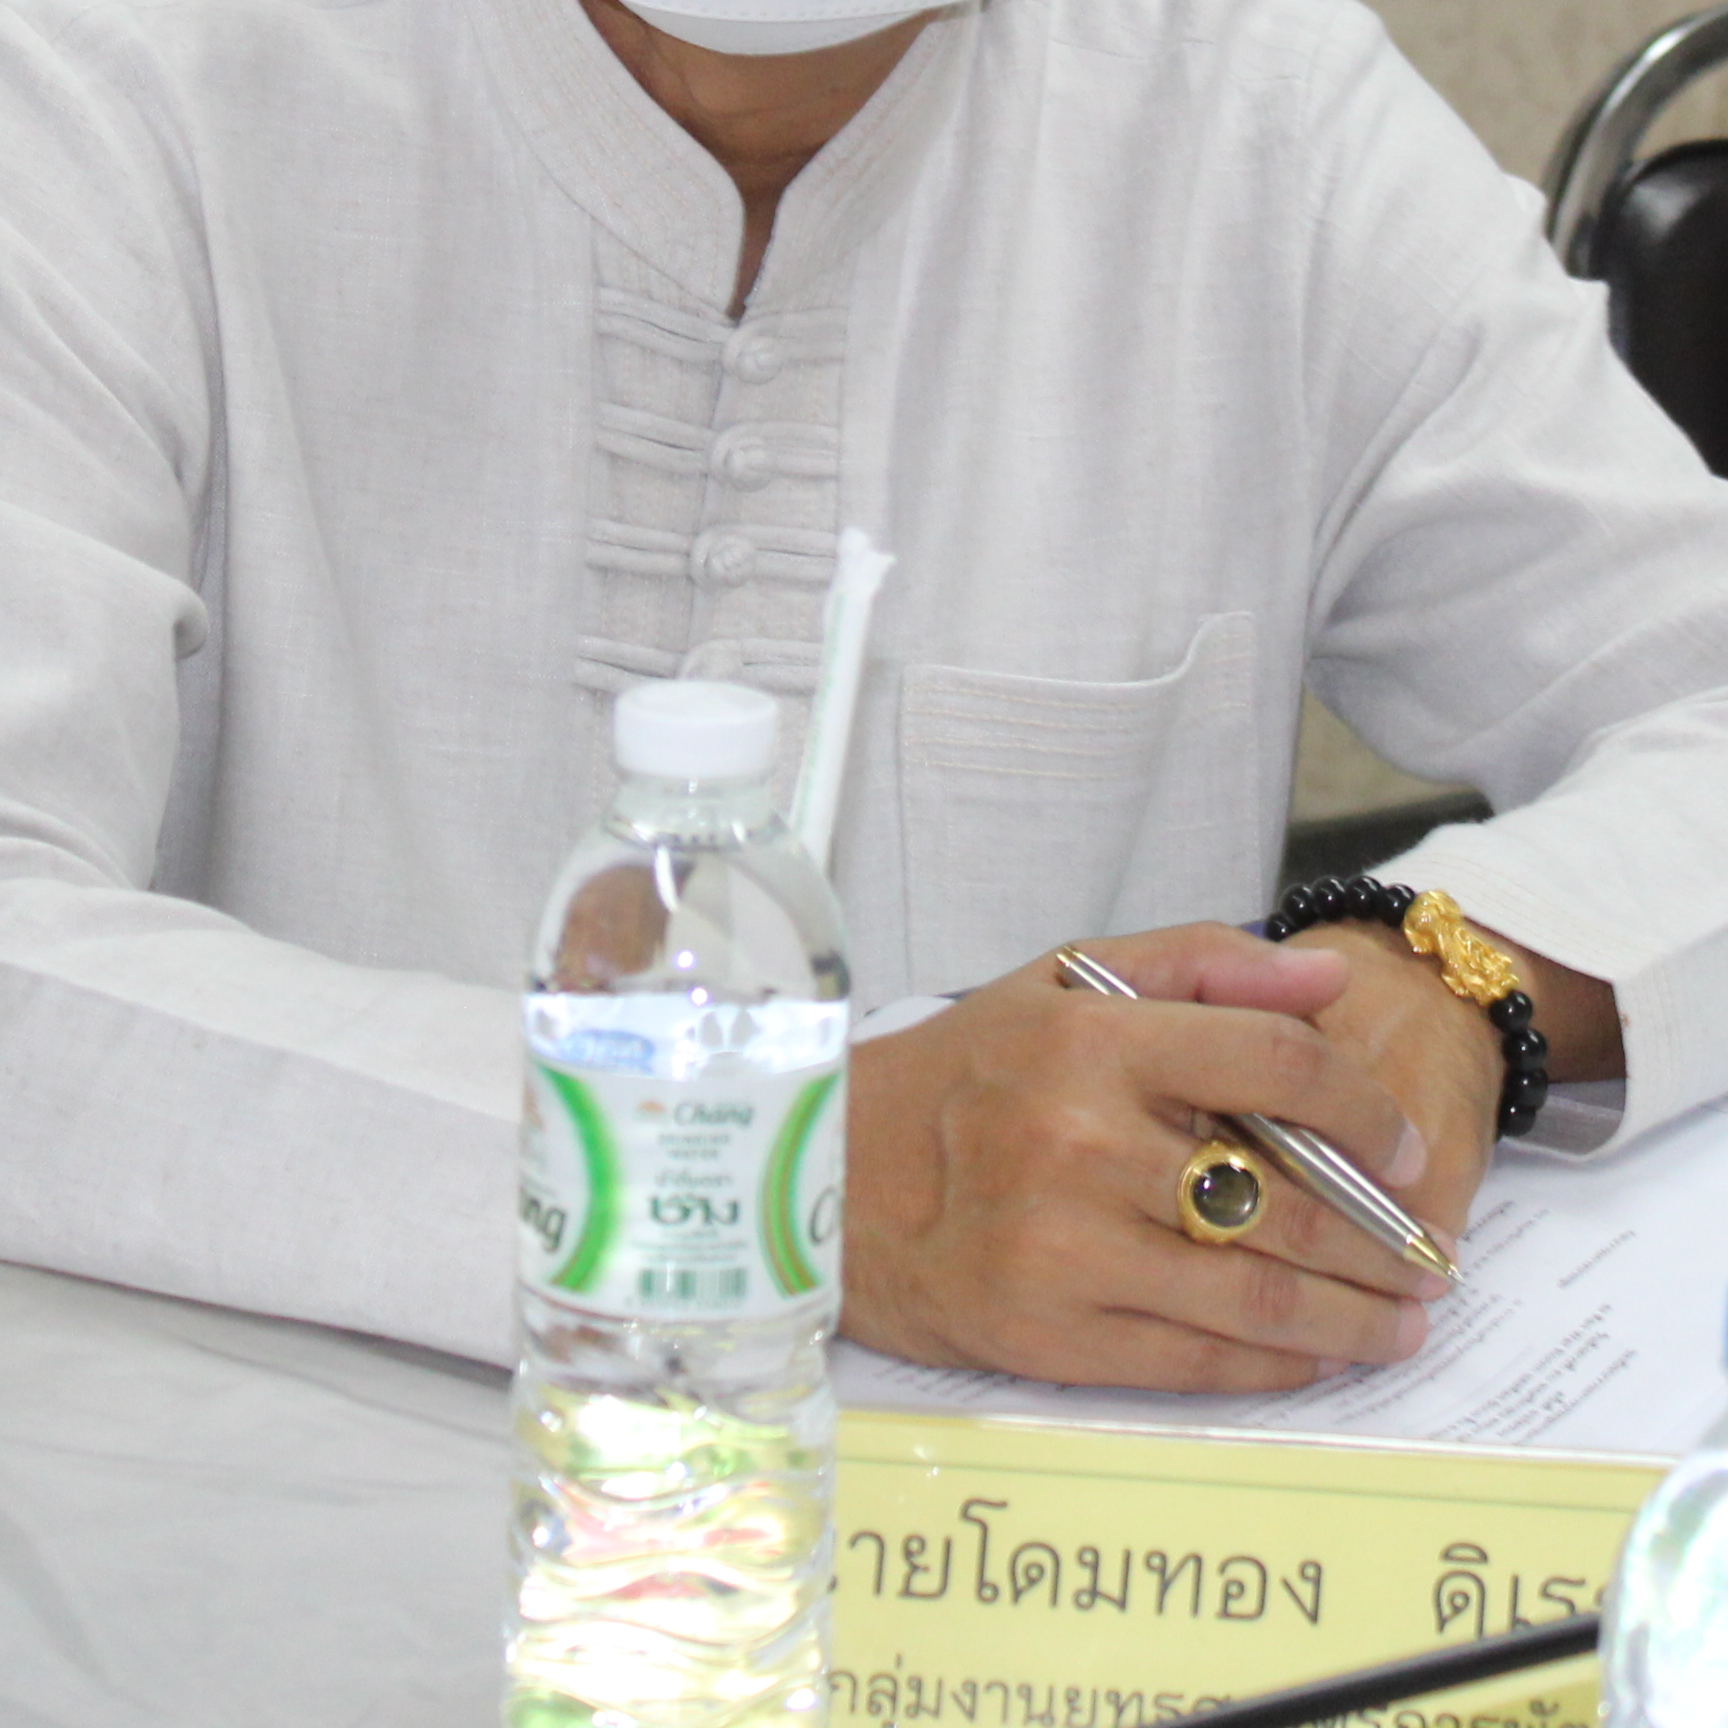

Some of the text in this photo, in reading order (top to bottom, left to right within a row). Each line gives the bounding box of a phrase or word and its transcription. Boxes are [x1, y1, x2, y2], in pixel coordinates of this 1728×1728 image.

[828, 1497, 1605, 1639] ายโดมทอง ดิเร
